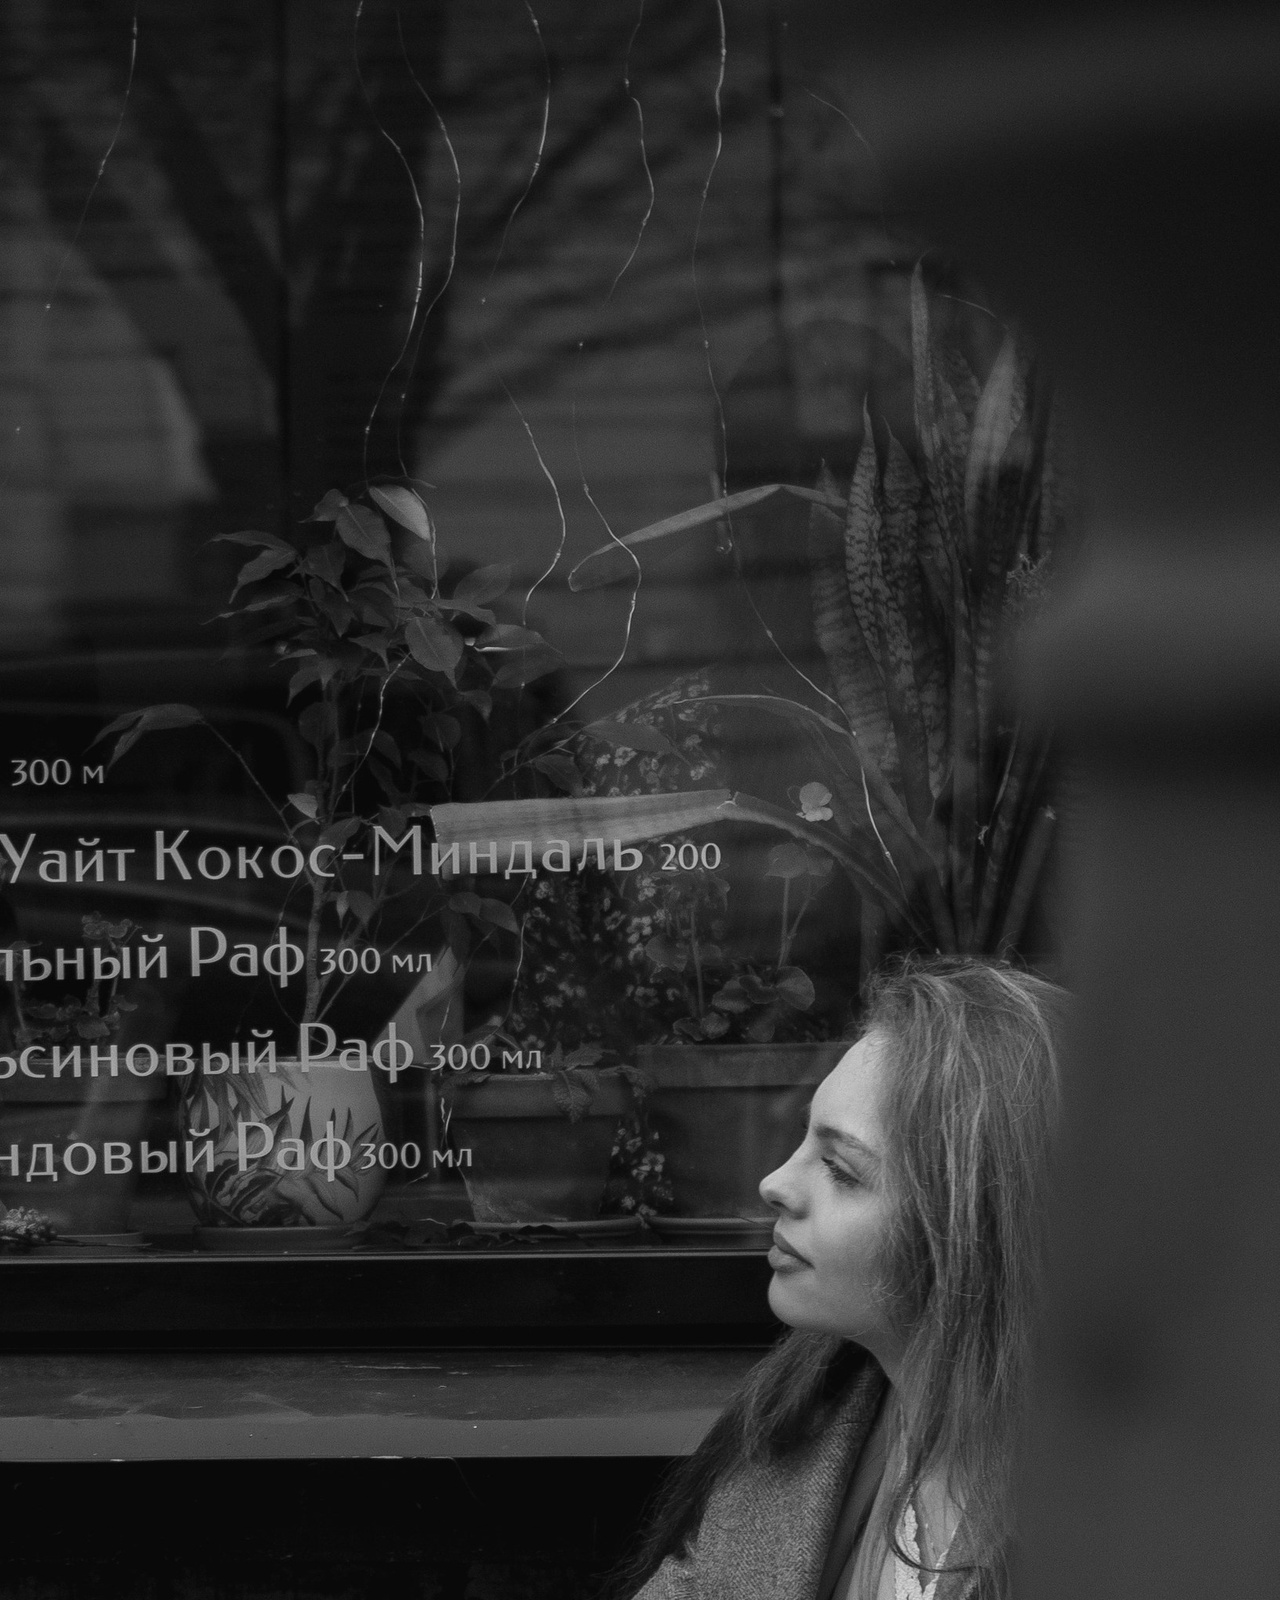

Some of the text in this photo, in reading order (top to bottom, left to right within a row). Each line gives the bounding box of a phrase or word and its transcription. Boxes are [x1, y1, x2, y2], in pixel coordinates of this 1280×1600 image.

[11, 758, 72, 787] 300
[82, 764, 105, 785] м
[154, 825, 644, 881] Кокос-Миндаль
[660, 842, 722, 872] 200
[190, 926, 305, 988] Раф
[320, 948, 381, 975] 300
[392, 952, 433, 974] мл
[300, 1022, 414, 1083] Раф
[429, 1043, 491, 1071] 300
[502, 1048, 542, 1070] мл
[237, 1121, 351, 1182] Раф
[360, 1142, 421, 1170] 300
[432, 1147, 473, 1169] мл
